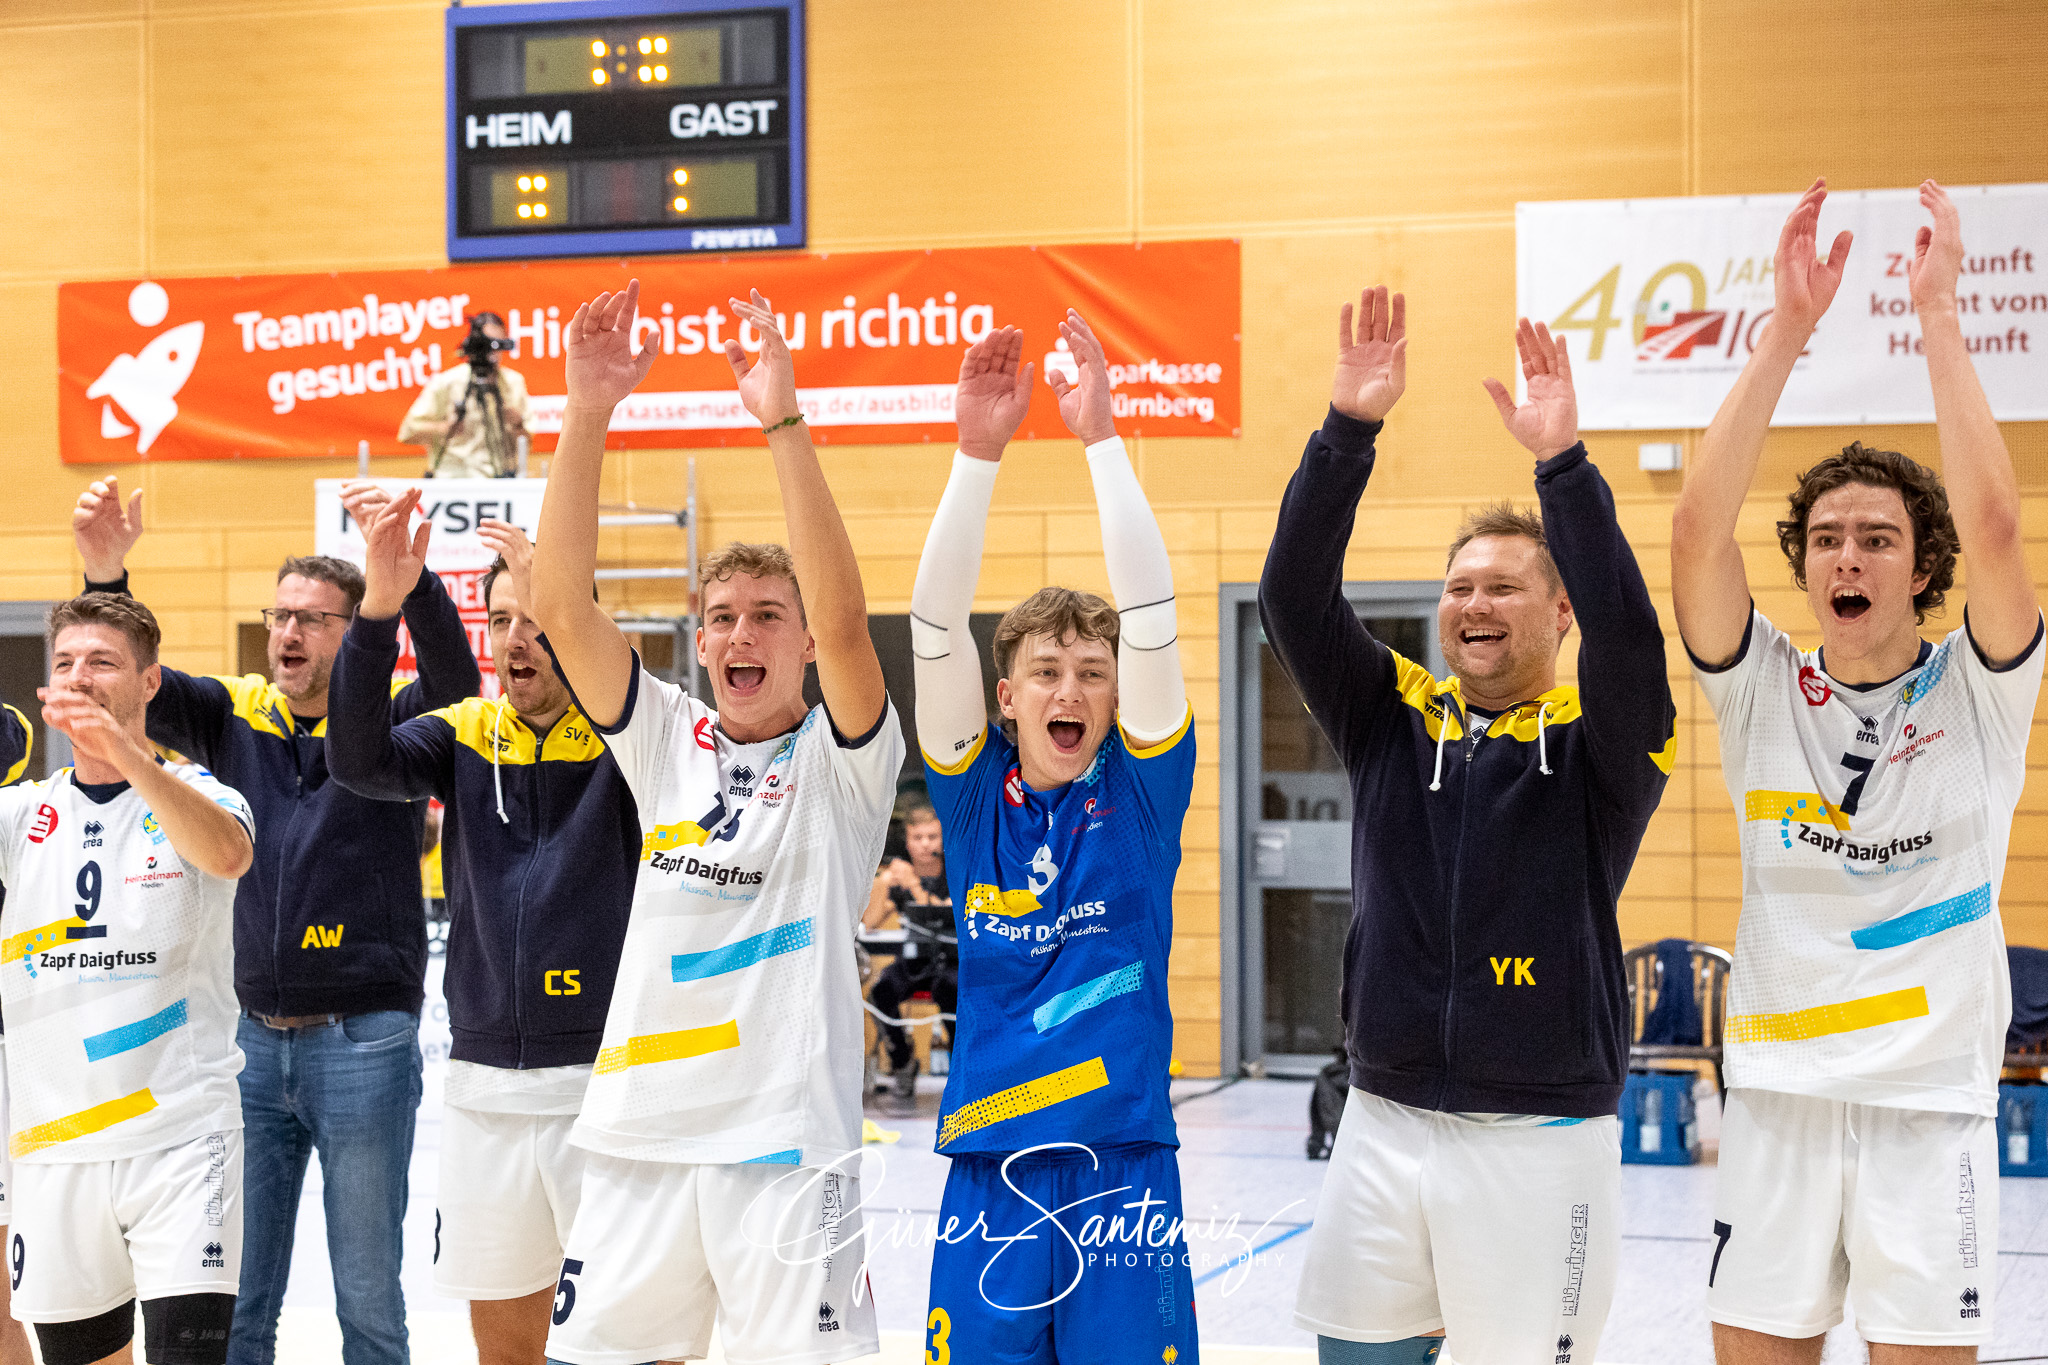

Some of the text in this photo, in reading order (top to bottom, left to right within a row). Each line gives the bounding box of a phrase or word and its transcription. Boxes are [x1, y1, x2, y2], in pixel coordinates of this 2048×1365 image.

[466, 100, 778, 149] HEIM GAST
[1885, 247, 2035, 278] Zunft
[1990, 294, 2048, 313] von
[233, 293, 470, 352] Teamplayer
[508, 305, 572, 360] Hi
[1888, 326, 2030, 356] Heunft
[267, 343, 442, 415] gesucht!
[1104, 358, 1223, 389] parkasse
[1109, 392, 1215, 422] ürnberg
[564, 727, 583, 741] SV
[729, 785, 753, 798] errea
[1839, 752, 1876, 816] 7
[1798, 823, 1933, 864] Zapf Daigfuss
[650, 851, 763, 886] Zapf Daigfuss
[75, 860, 102, 921] 9
[301, 924, 344, 949] AW
[984, 914, 1031, 941] Zapf
[40, 950, 157, 971] Zapf Daigfuss
[1490, 957, 1536, 986] YK
[544, 969, 581, 996] CS
[12, 1233, 25, 1291] 9
[202, 1259, 224, 1268] errea
[1708, 1219, 1732, 1288] 7
[818, 1320, 840, 1332] errea
[925, 1308, 951, 1365] 3
